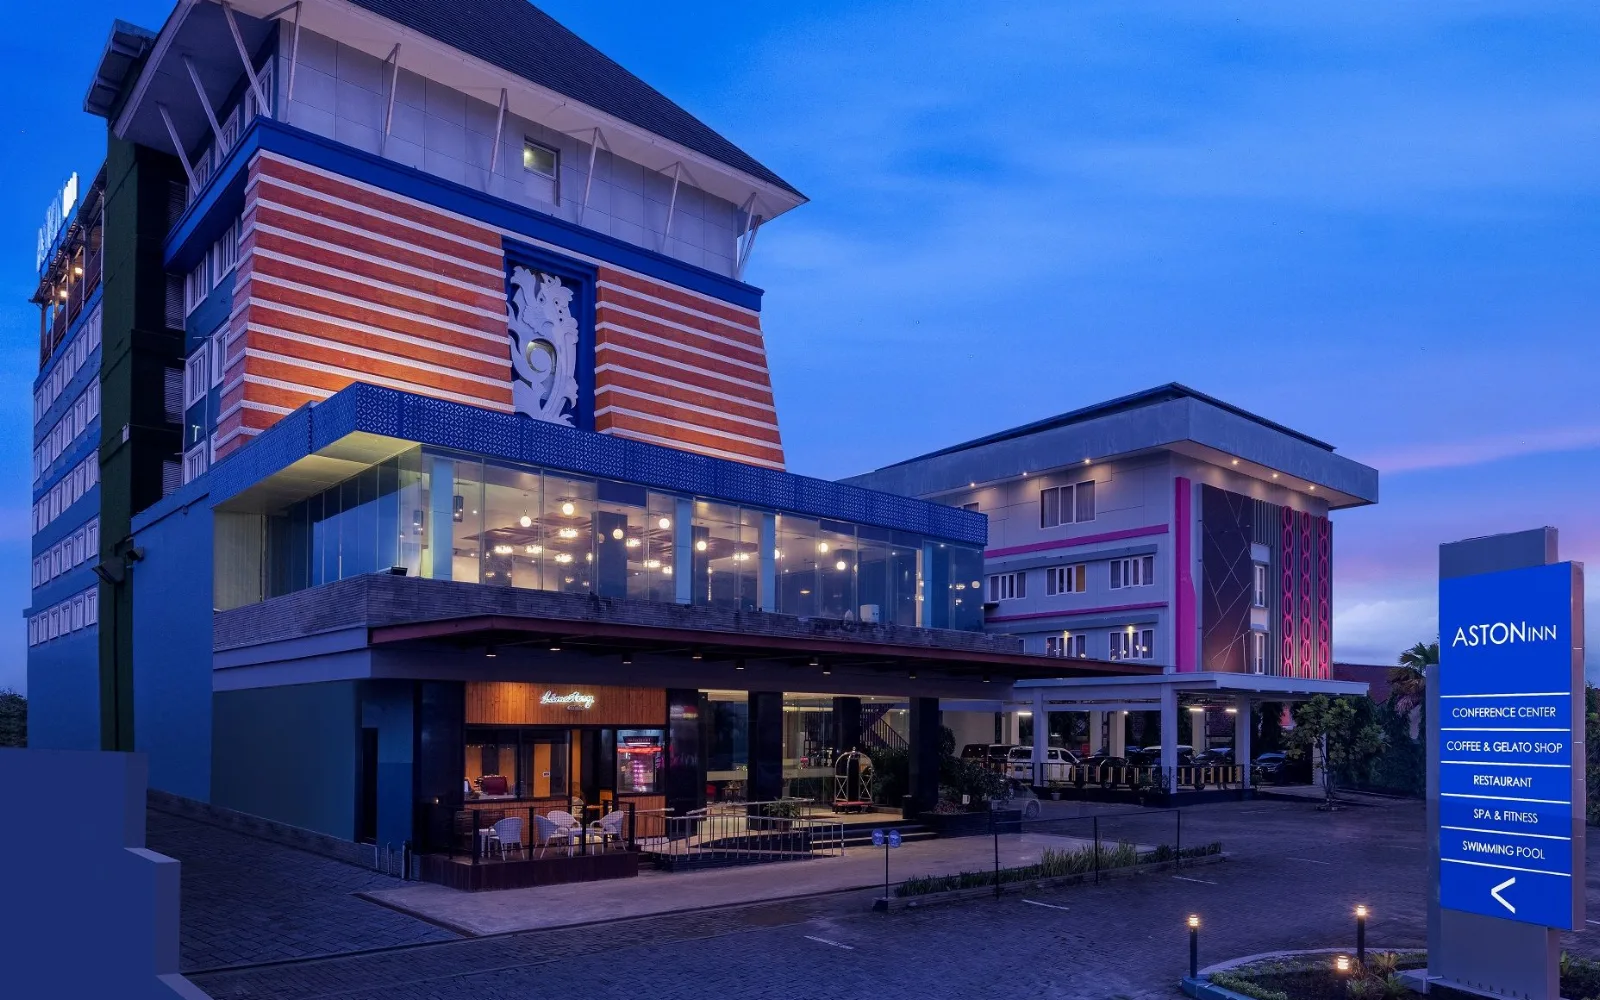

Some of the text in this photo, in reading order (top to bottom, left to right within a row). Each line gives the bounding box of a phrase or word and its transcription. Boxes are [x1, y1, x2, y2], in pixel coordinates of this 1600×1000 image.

[1452, 706, 1556, 718] CONFERENCE CENTER
[1446, 740, 1563, 754] COFFEE & GELATO SHOP
[1473, 774, 1533, 788] RESTAURANT
[1473, 808, 1538, 824] SPA & FITNESS
[1462, 840, 1546, 860] SWIMMING POOL
